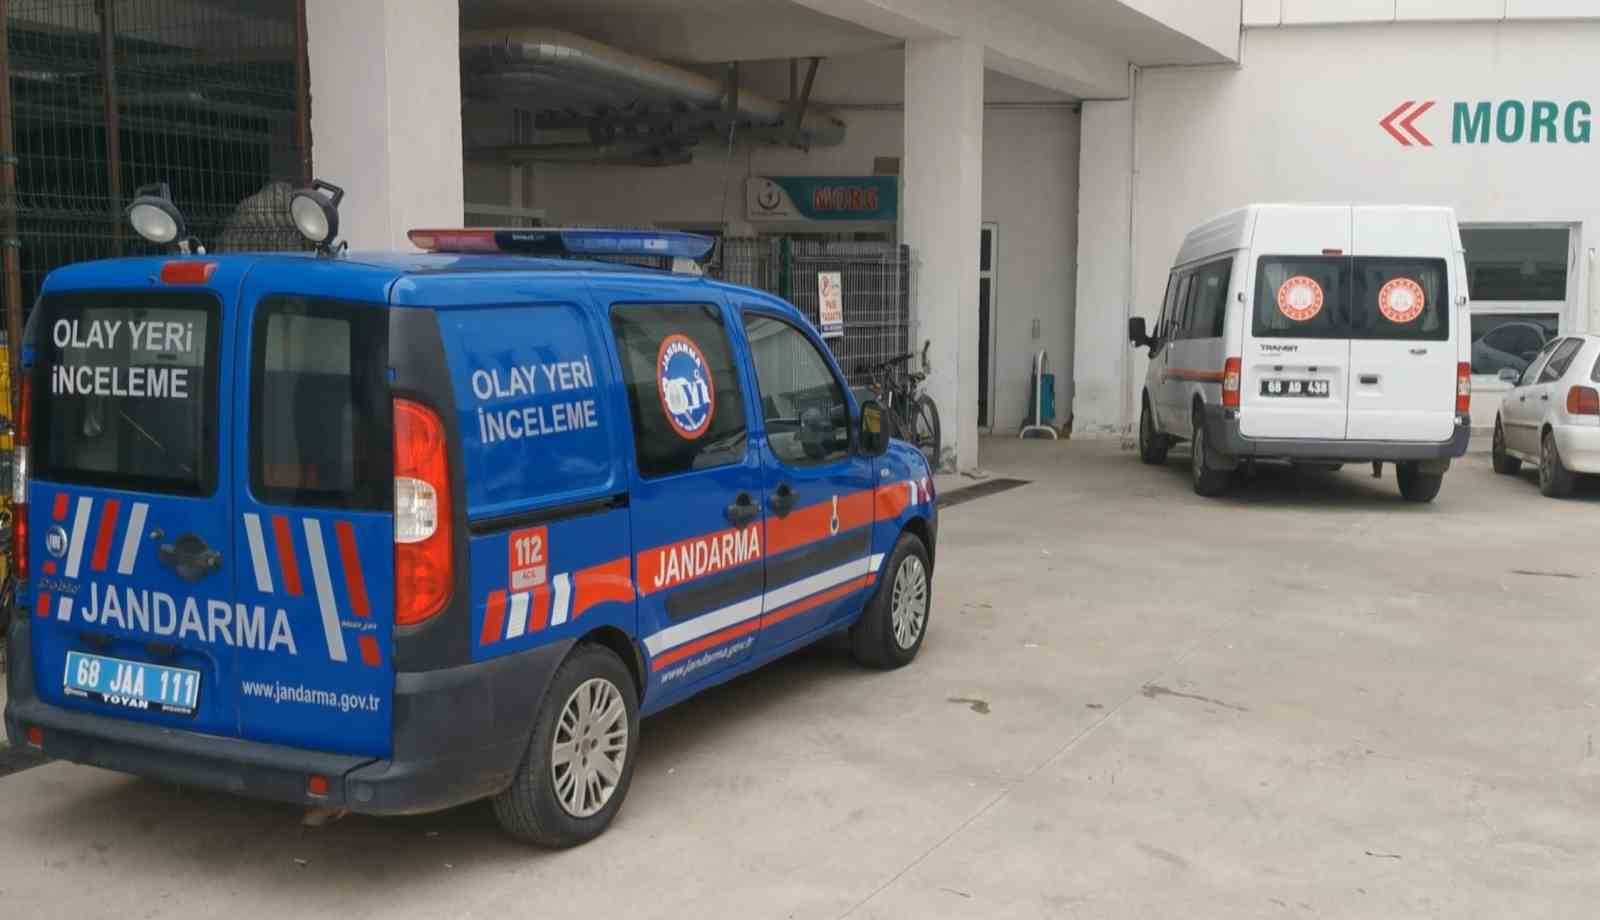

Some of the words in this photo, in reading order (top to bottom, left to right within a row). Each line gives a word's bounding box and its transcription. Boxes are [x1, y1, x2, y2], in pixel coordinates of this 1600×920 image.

[1452, 99, 1592, 144] MORG
[814, 187, 877, 209] MORG
[53, 319, 122, 349] OLAY
[472, 364, 537, 400] OLAY
[515, 535, 542, 567] 112
[654, 526, 761, 588] JANDARMA
[81, 581, 298, 655] JANDARMA
[77, 657, 101, 688] 68
[110, 663, 144, 697] JAA
[160, 669, 194, 706] 111
[242, 679, 380, 712] www.jandarma.gov.tr
[102, 693, 149, 710] TOYAN
